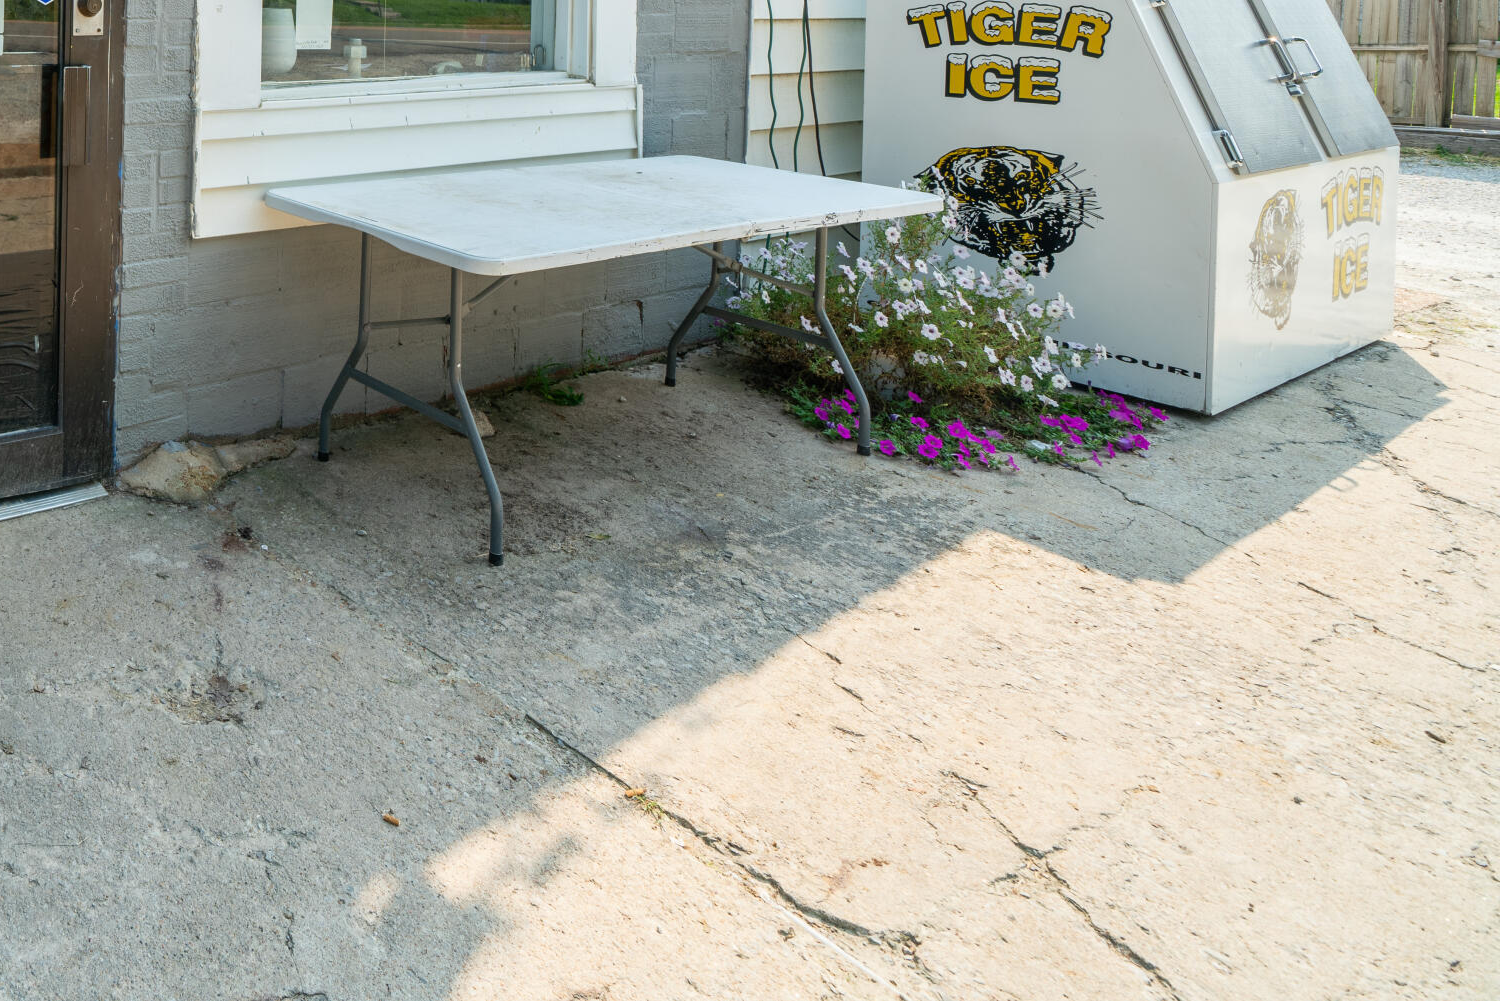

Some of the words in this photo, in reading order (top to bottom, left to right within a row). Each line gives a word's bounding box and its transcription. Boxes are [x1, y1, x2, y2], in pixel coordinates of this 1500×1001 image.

[907, 0, 1113, 58] TIGER
[945, 52, 1061, 104] ICE
[1321, 165, 1384, 240] TIGER
[1332, 232, 1369, 302] ICE
